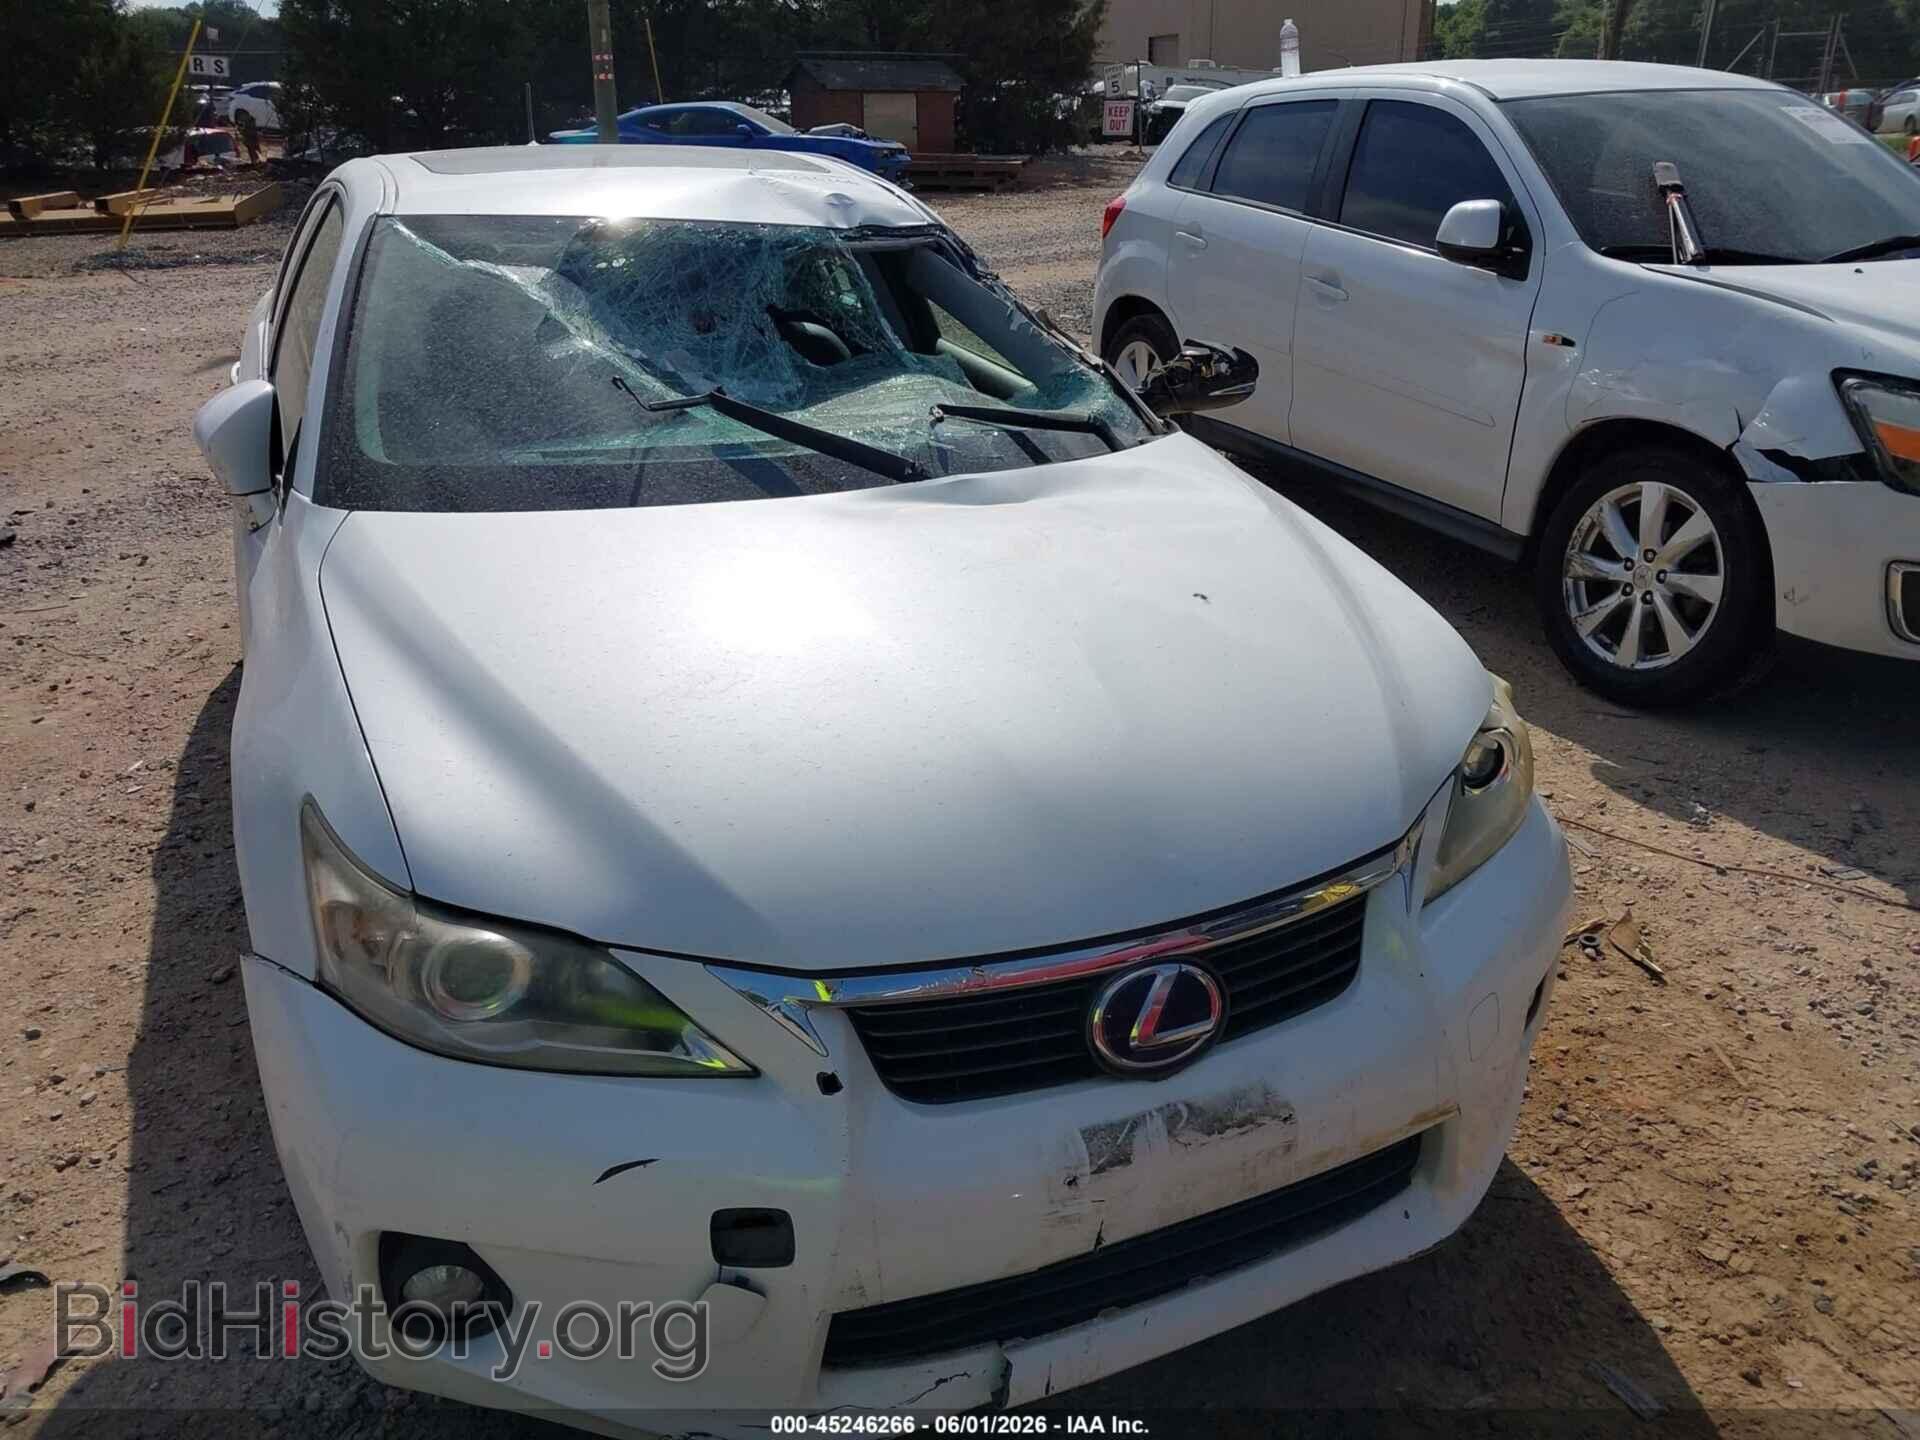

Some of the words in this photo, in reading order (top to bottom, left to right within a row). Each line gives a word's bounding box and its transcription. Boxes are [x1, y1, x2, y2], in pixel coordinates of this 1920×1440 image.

[1111, 80, 1120, 94] 5
[1108, 105, 1130, 117] KEEP
[1109, 119, 1127, 131] OUT
